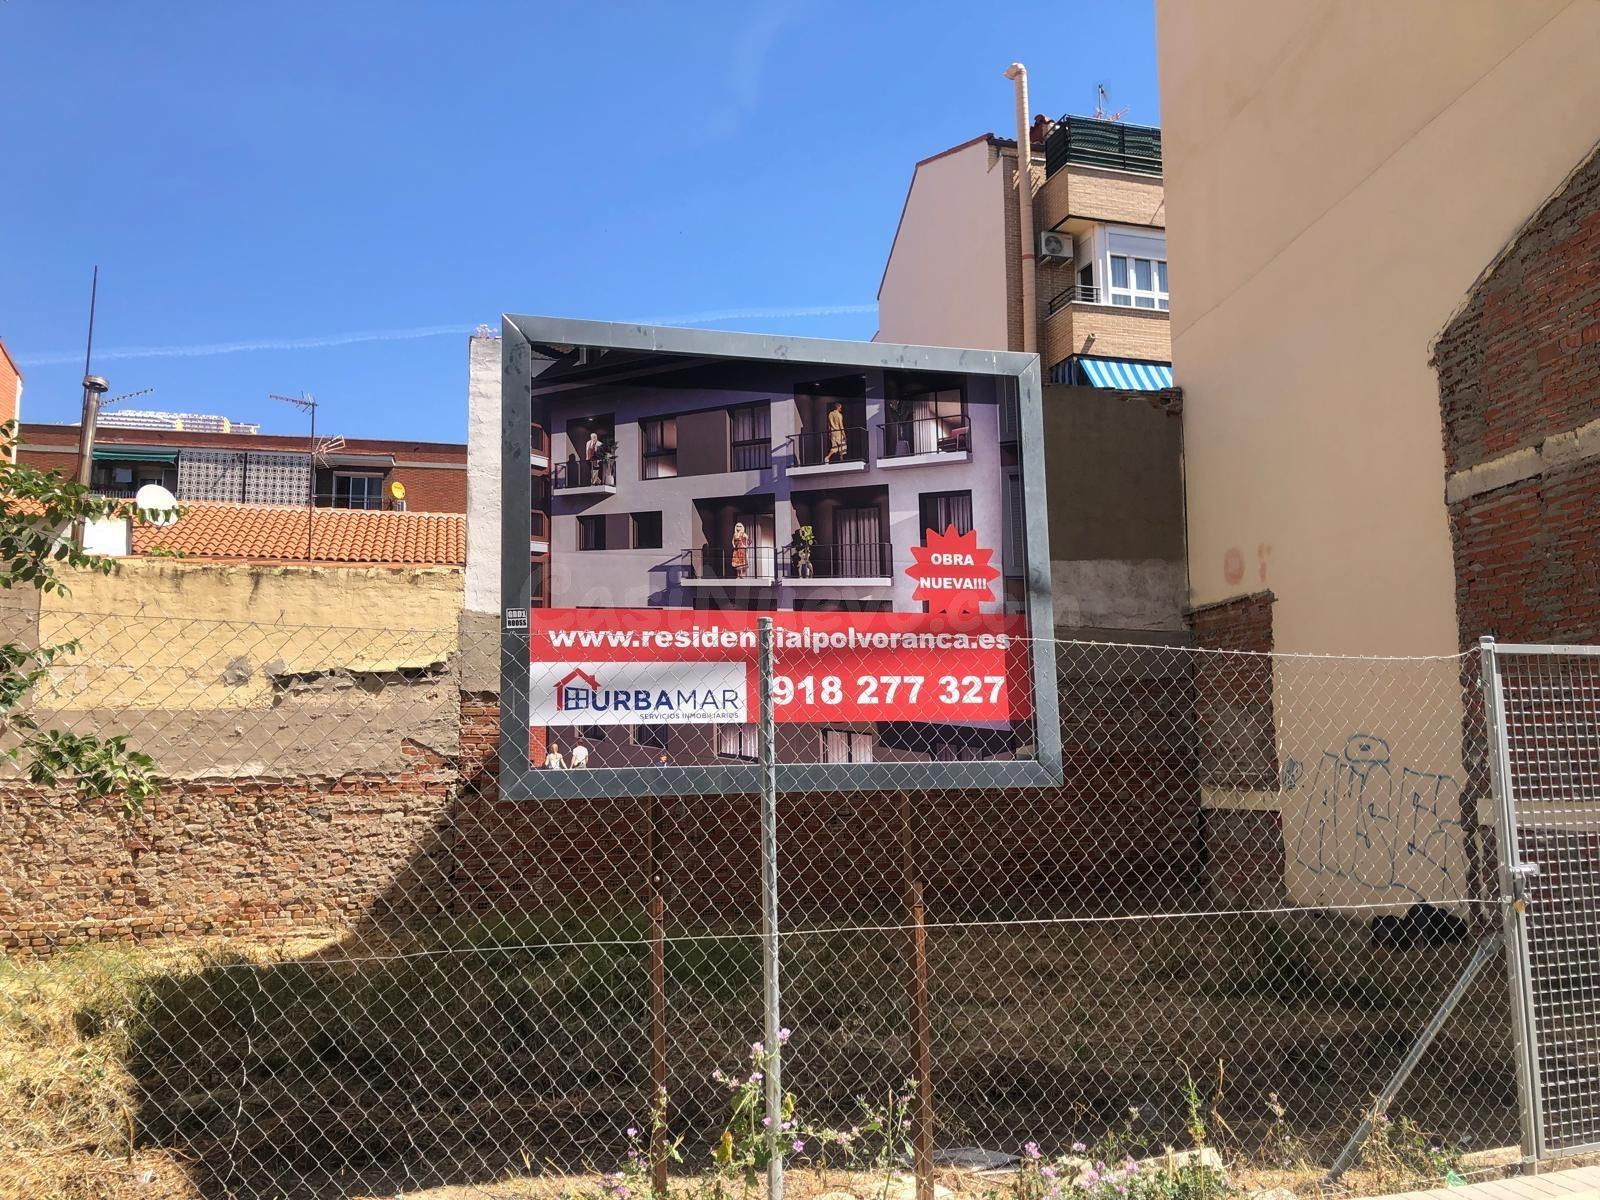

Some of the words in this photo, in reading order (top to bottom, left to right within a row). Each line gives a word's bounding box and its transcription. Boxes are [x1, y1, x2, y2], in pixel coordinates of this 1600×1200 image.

[930, 553, 974, 566] OBRA
[919, 577, 987, 590] NUEVA!!!
[548, 625, 1010, 654] www.residenialpolvoranca.es
[591, 689, 739, 711] URBAMAR
[773, 675, 843, 705] 918
[857, 675, 925, 705] 277
[938, 675, 1005, 705] 327
